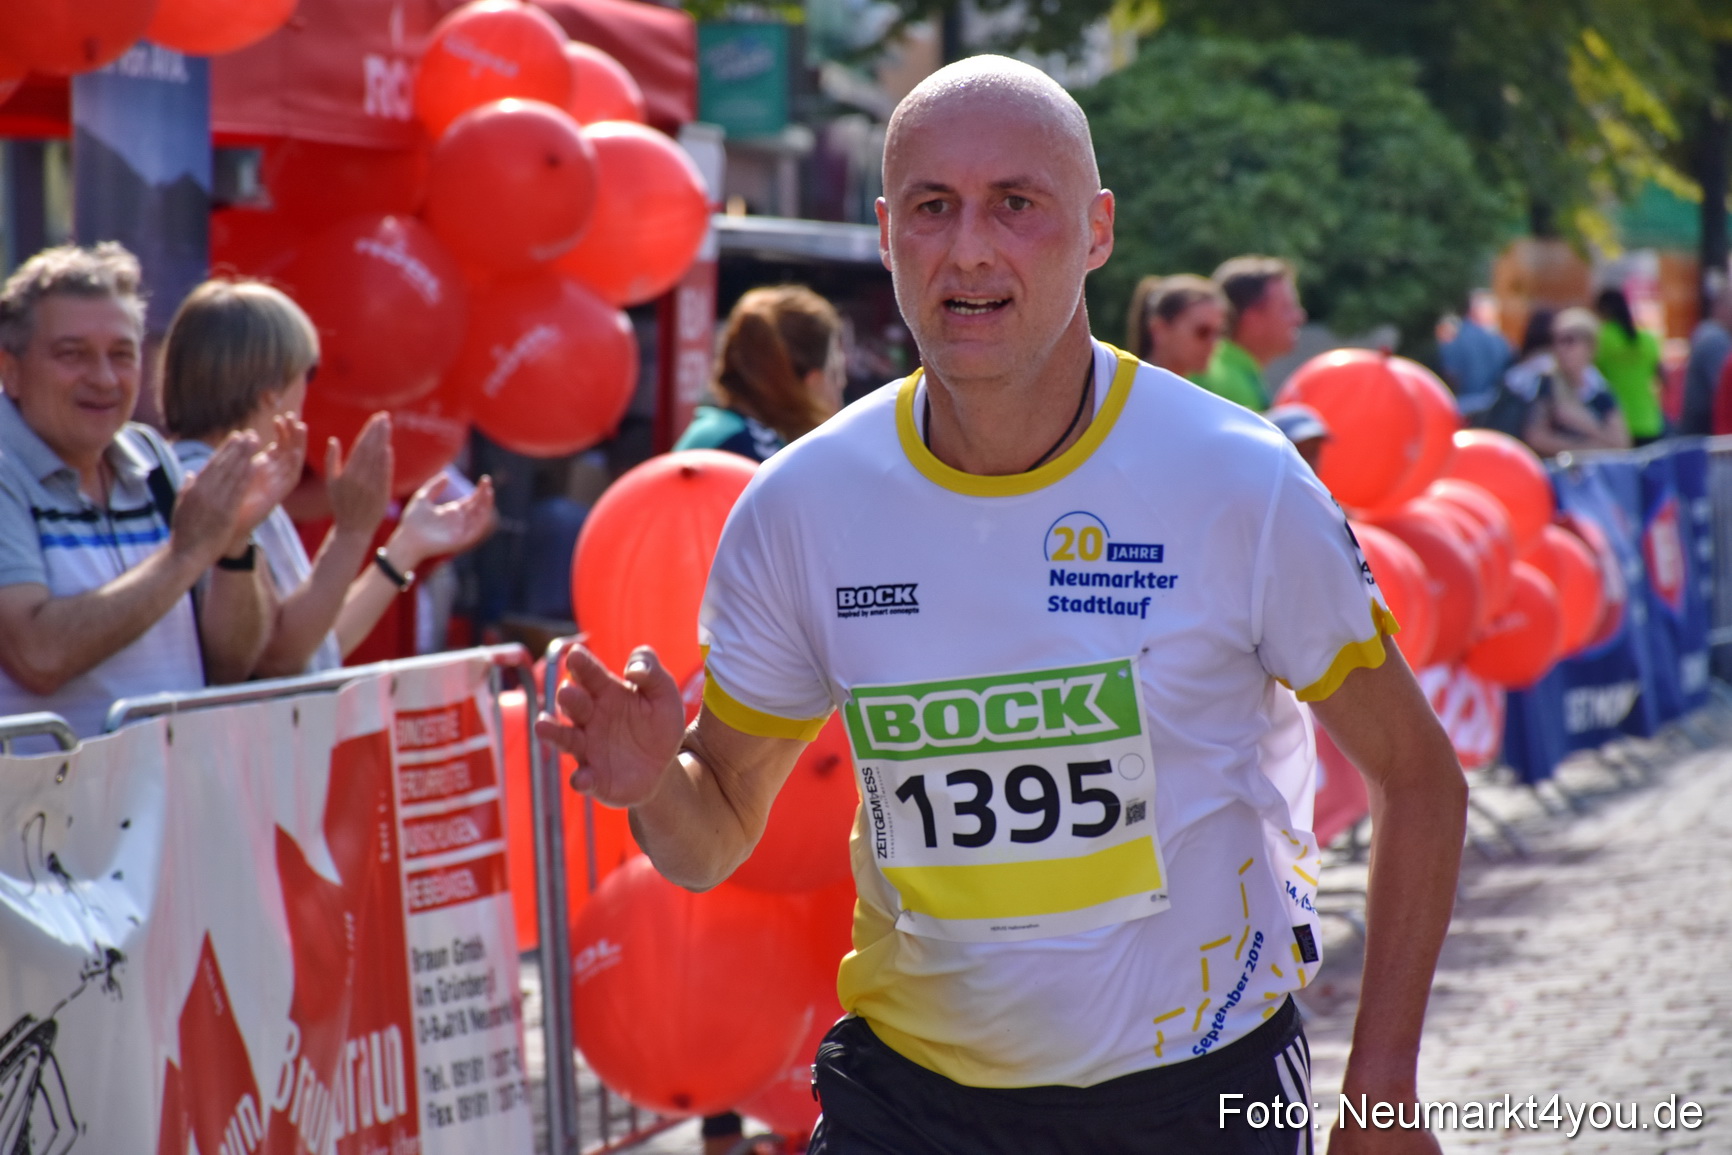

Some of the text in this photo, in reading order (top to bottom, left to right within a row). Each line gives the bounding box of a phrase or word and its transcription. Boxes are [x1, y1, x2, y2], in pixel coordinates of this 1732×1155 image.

[1052, 526, 1159, 562] 20 JAHRE
[836, 583, 919, 610] BOCK
[1049, 569, 1178, 589] Neumarkter
[1047, 595, 1151, 619] Stadtlauf
[862, 677, 1109, 747] BOCK
[895, 759, 1121, 848] 1395
[1192, 931, 1264, 1056] September 2019
